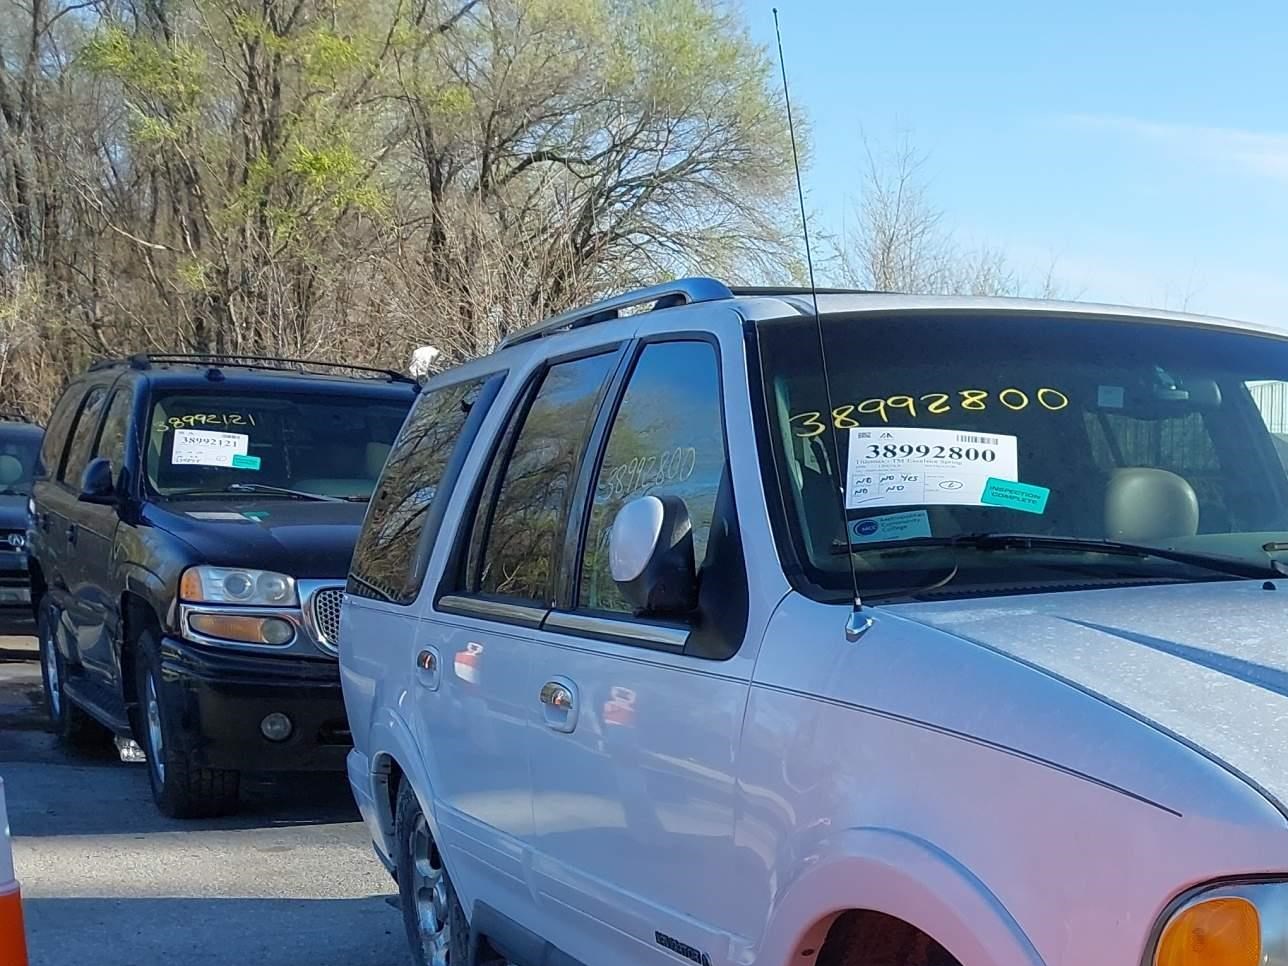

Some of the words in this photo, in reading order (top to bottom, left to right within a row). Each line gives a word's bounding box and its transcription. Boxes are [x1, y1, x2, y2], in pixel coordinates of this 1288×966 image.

[788, 388, 1069, 437] 38992800
[156, 413, 255, 432] 38992121
[183, 436, 237, 447] 38992121
[865, 444, 996, 462] 38992800
[598, 447, 695, 501] 38992800
[990, 486, 1041, 500] INSPECTION
[991, 491, 1039, 504] COMPLETE
